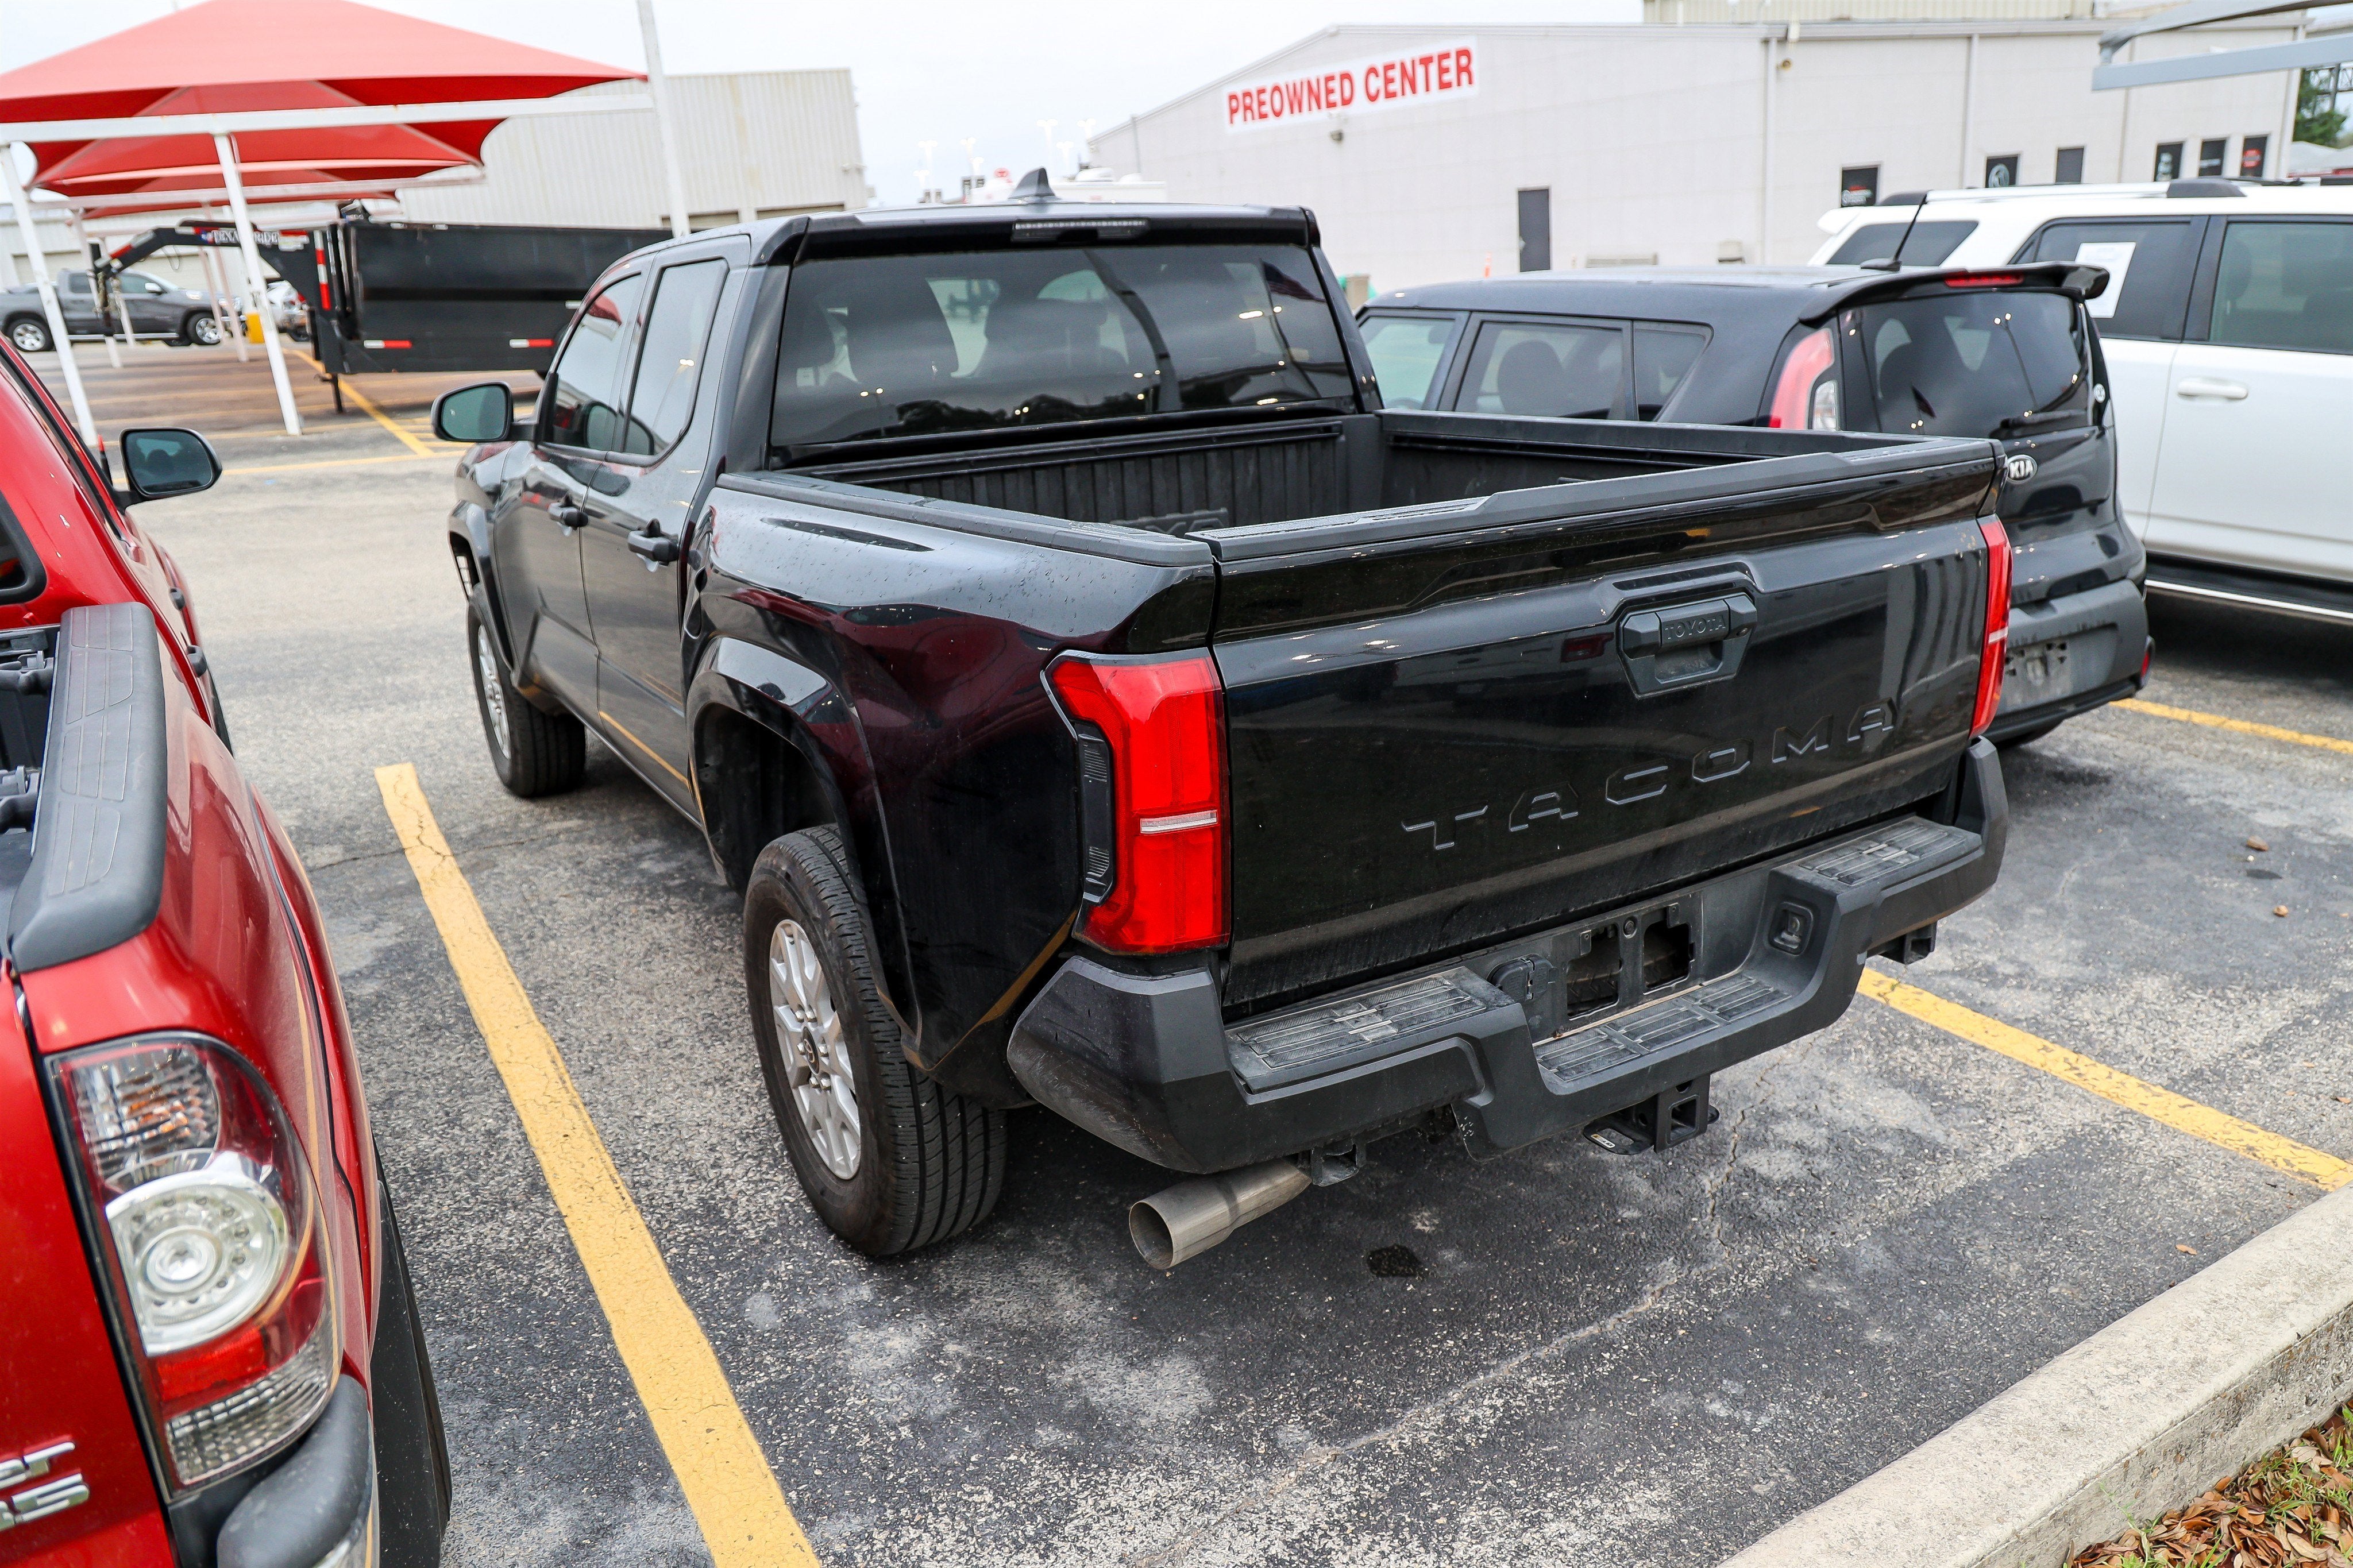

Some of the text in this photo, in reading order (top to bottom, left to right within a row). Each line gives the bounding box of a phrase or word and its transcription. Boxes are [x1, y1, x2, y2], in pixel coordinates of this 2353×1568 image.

[1228, 49, 1473, 124] PREOWNED CENTER
[2009, 459, 2034, 480] KIA
[1664, 614, 1726, 640] TOYOTA
[1401, 697, 1897, 849] TACOMA
